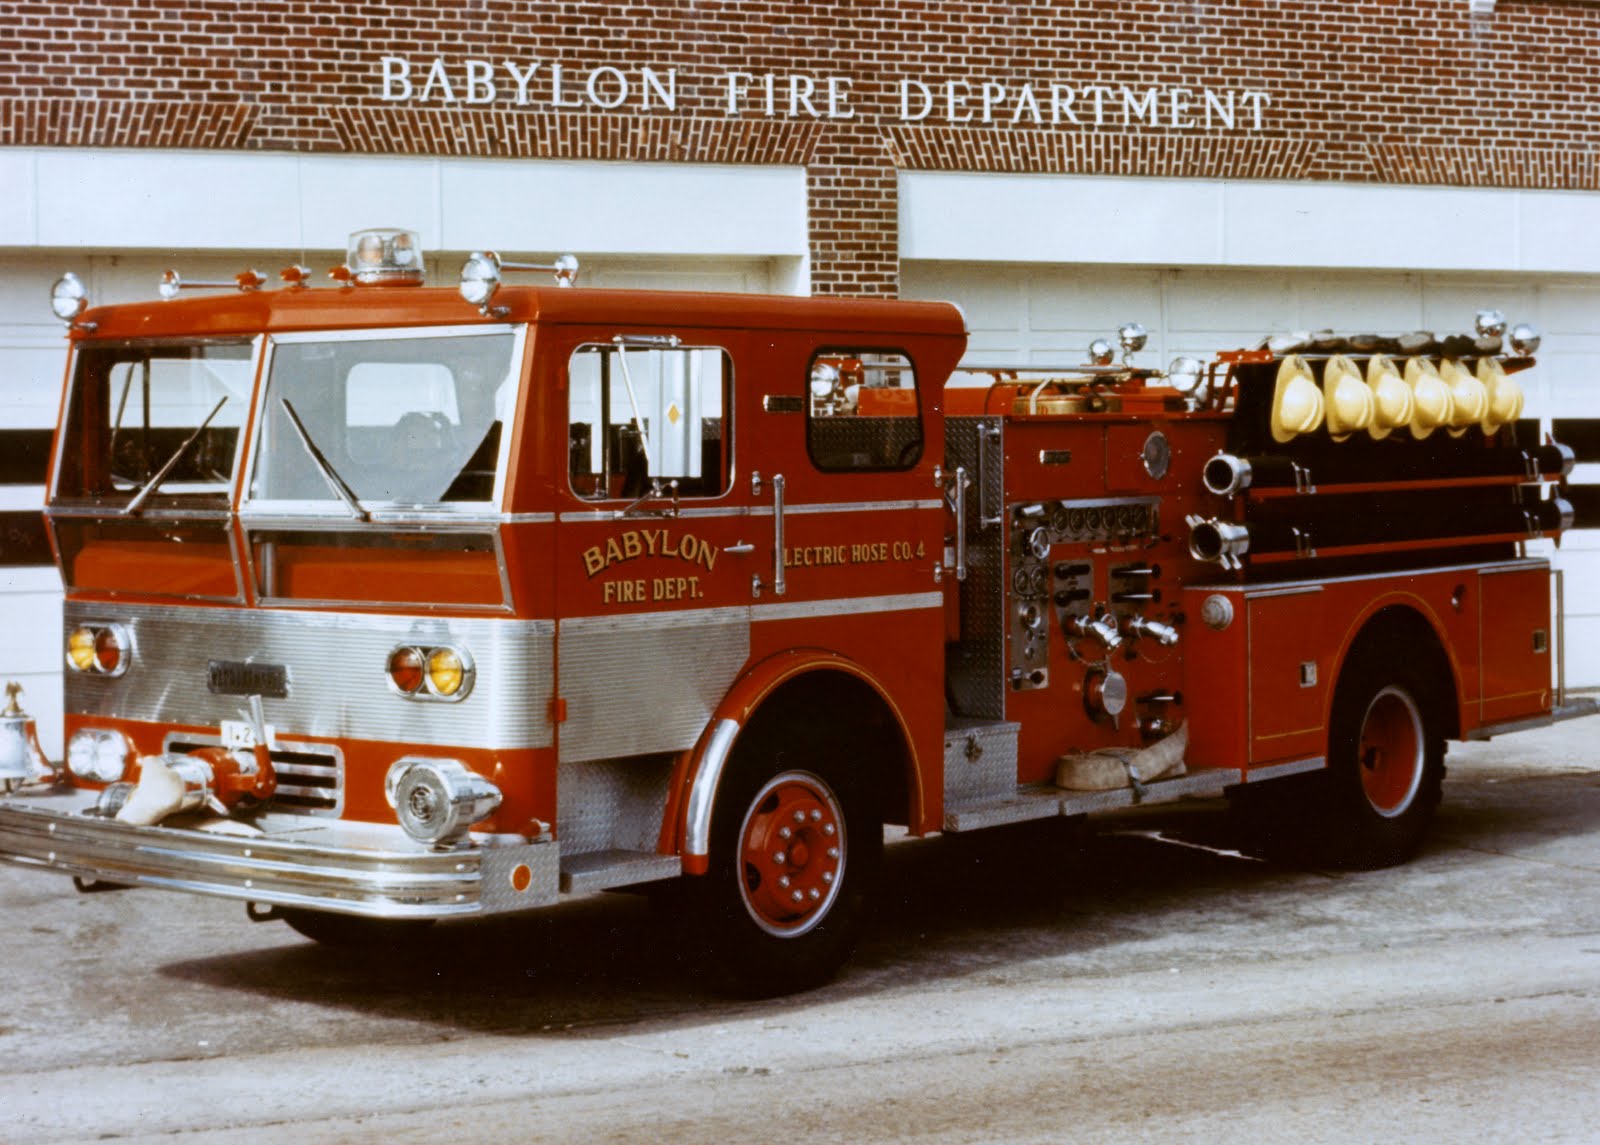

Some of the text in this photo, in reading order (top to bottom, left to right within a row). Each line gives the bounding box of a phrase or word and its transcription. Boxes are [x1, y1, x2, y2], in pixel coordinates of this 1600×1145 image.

[380, 56, 1271, 131] BABYLON FIRE DEPARTMENT
[582, 529, 719, 576] BABYLON
[781, 537, 926, 567] LECTRIC HOSE CO. 4
[603, 575, 704, 604] FIRE DEPT.
